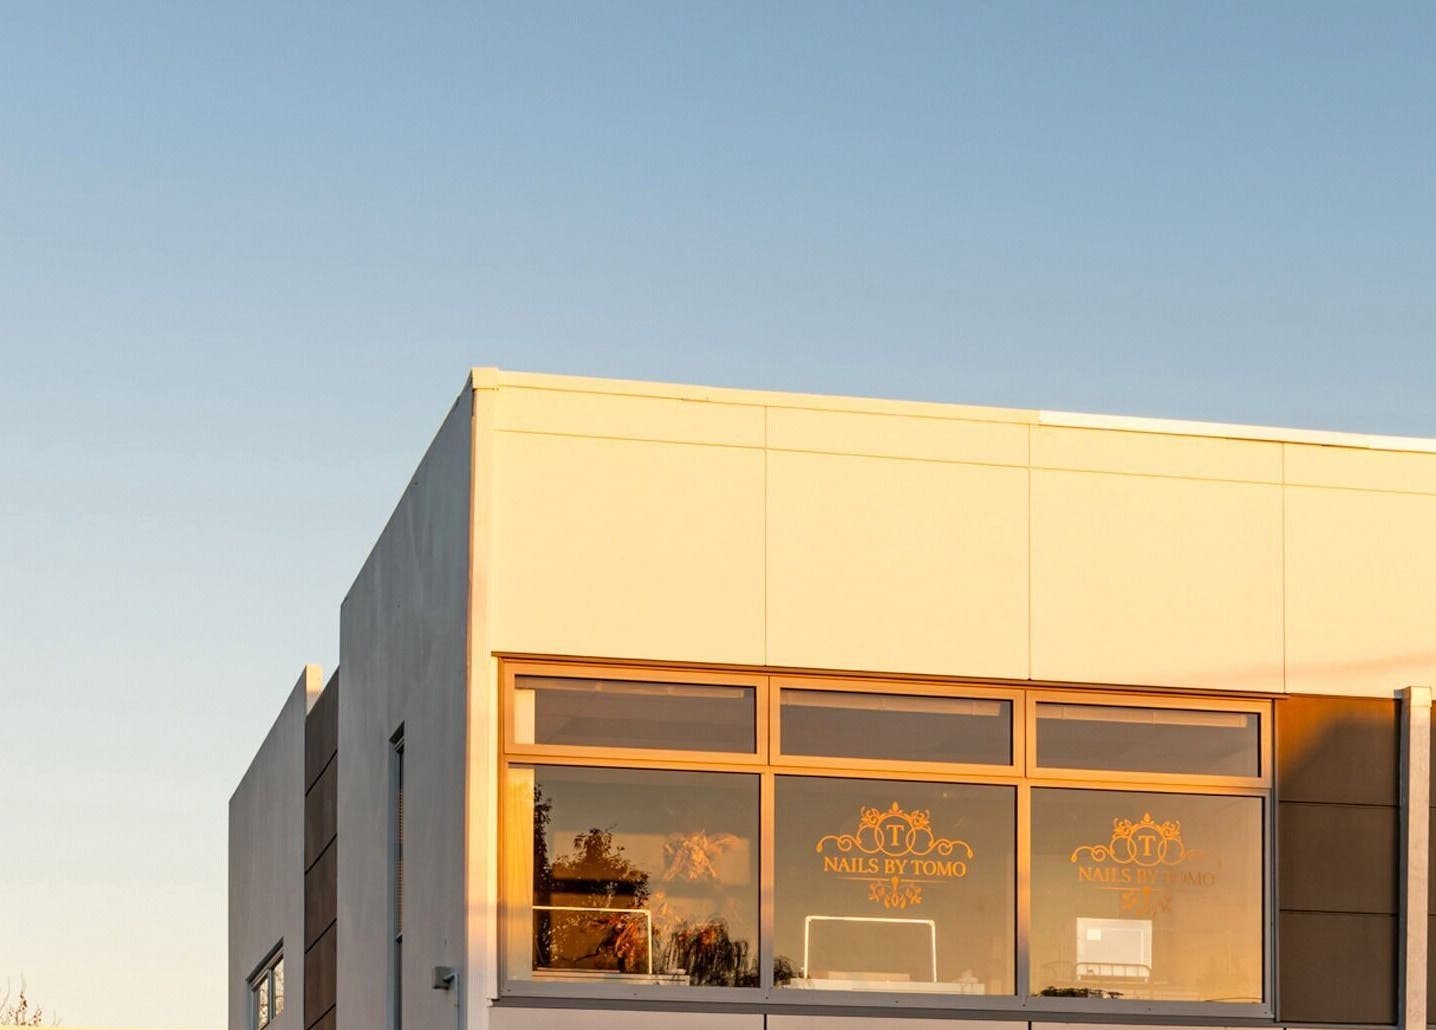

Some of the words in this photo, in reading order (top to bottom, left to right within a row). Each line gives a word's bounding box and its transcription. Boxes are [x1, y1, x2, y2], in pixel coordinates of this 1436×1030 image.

[886, 824, 904, 846] T
[1138, 835, 1156, 857] T
[824, 856, 879, 874] NAILS
[884, 859, 908, 874] BY
[911, 860, 967, 877] TOMO
[1078, 865, 1132, 883] NAILS
